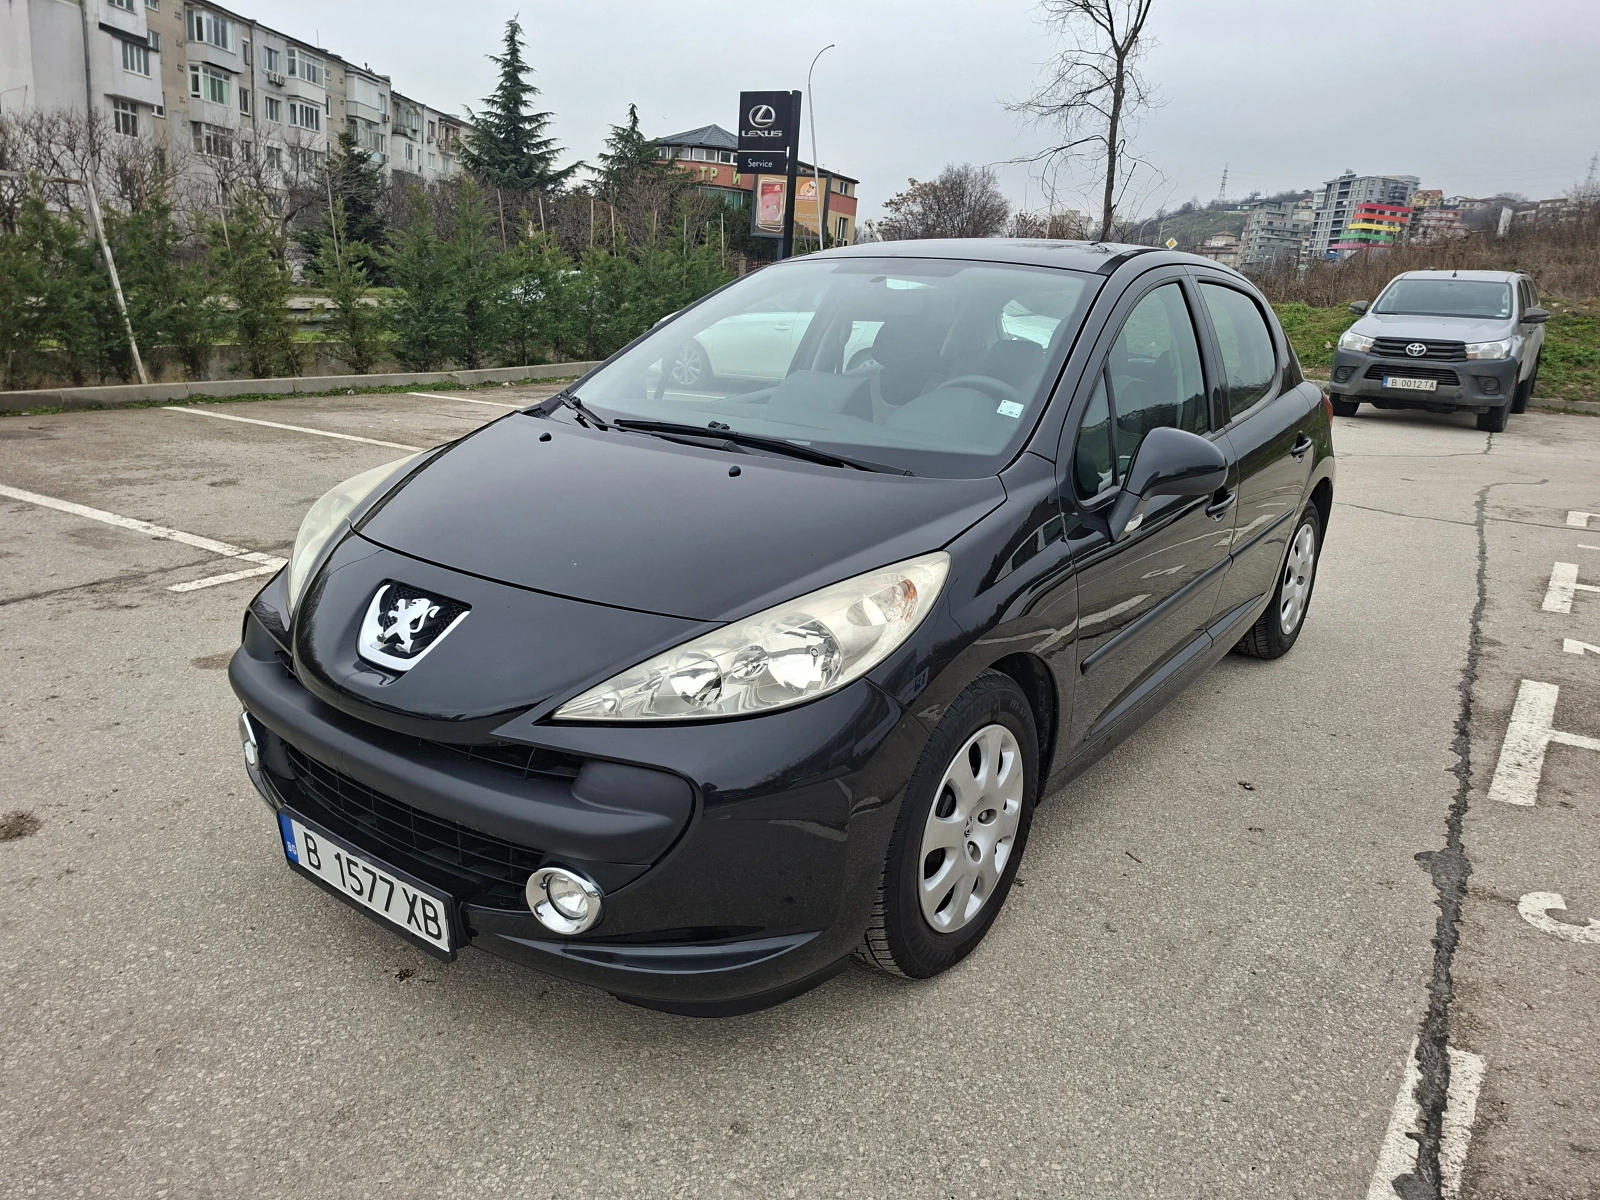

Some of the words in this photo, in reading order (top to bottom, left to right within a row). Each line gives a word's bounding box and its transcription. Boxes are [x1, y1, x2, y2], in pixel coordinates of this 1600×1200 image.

[747, 158, 773, 168] Service
[1391, 378, 1397, 387] B
[1401, 379, 1422, 389] 0012
[1424, 381, 1435, 389] TA
[286, 840, 298, 856] BG
[303, 831, 322, 870] B
[334, 852, 395, 913] 1577
[401, 886, 442, 941] XB
